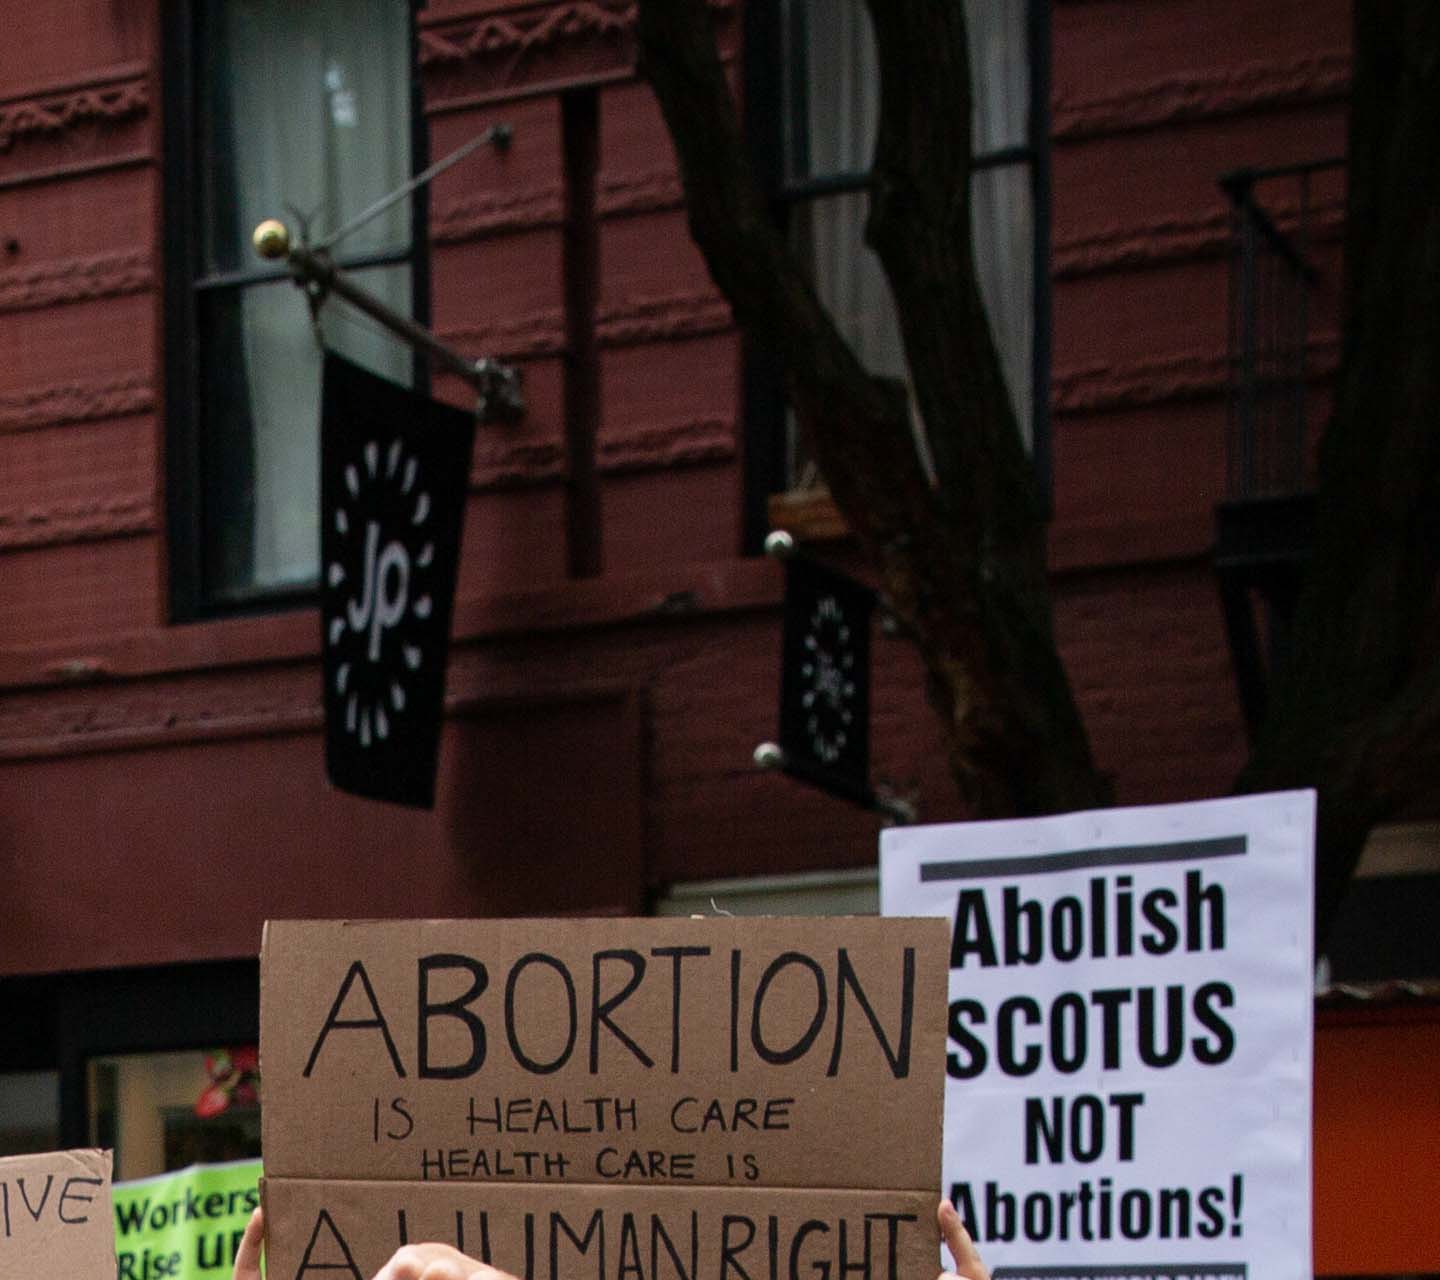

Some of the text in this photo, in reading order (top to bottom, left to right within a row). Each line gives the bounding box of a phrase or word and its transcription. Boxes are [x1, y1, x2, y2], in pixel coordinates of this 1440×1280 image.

[950, 868, 1227, 970] Abolish
[302, 945, 916, 1081] ABORTION
[946, 981, 1237, 1081] SCOTUS
[374, 1096, 795, 1142] IS HEALTH CARE
[1024, 1093, 1145, 1165] NOT
[421, 1148, 761, 1182] HEALTH CARE IS
[115, 1187, 260, 1236] Workers
[950, 1173, 1245, 1243] Abortions!
